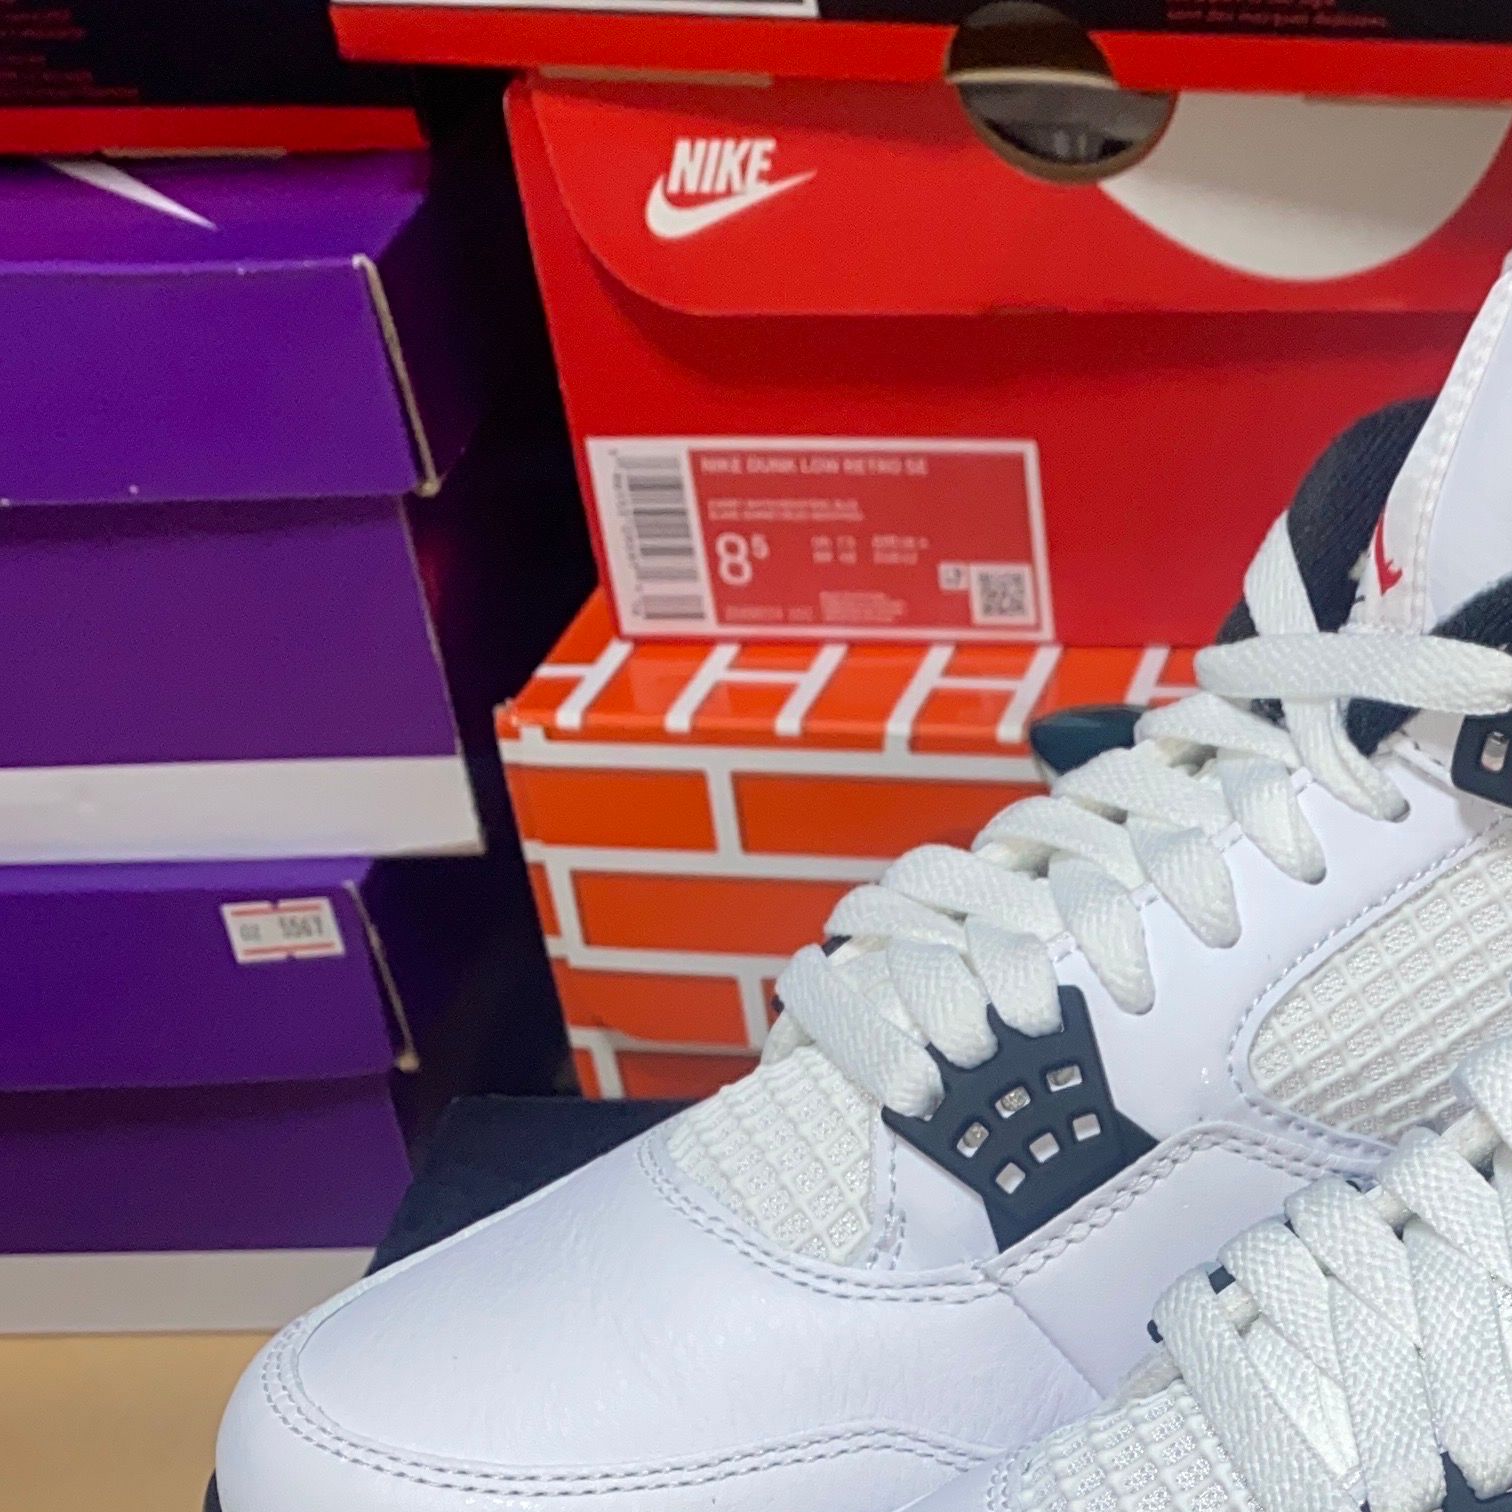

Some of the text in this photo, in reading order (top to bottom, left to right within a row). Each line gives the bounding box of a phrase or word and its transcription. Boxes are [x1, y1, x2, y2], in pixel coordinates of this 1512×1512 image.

[666, 136, 778, 196] NIKE
[701, 456, 742, 474] NIKE
[746, 456, 797, 474] DUNK
